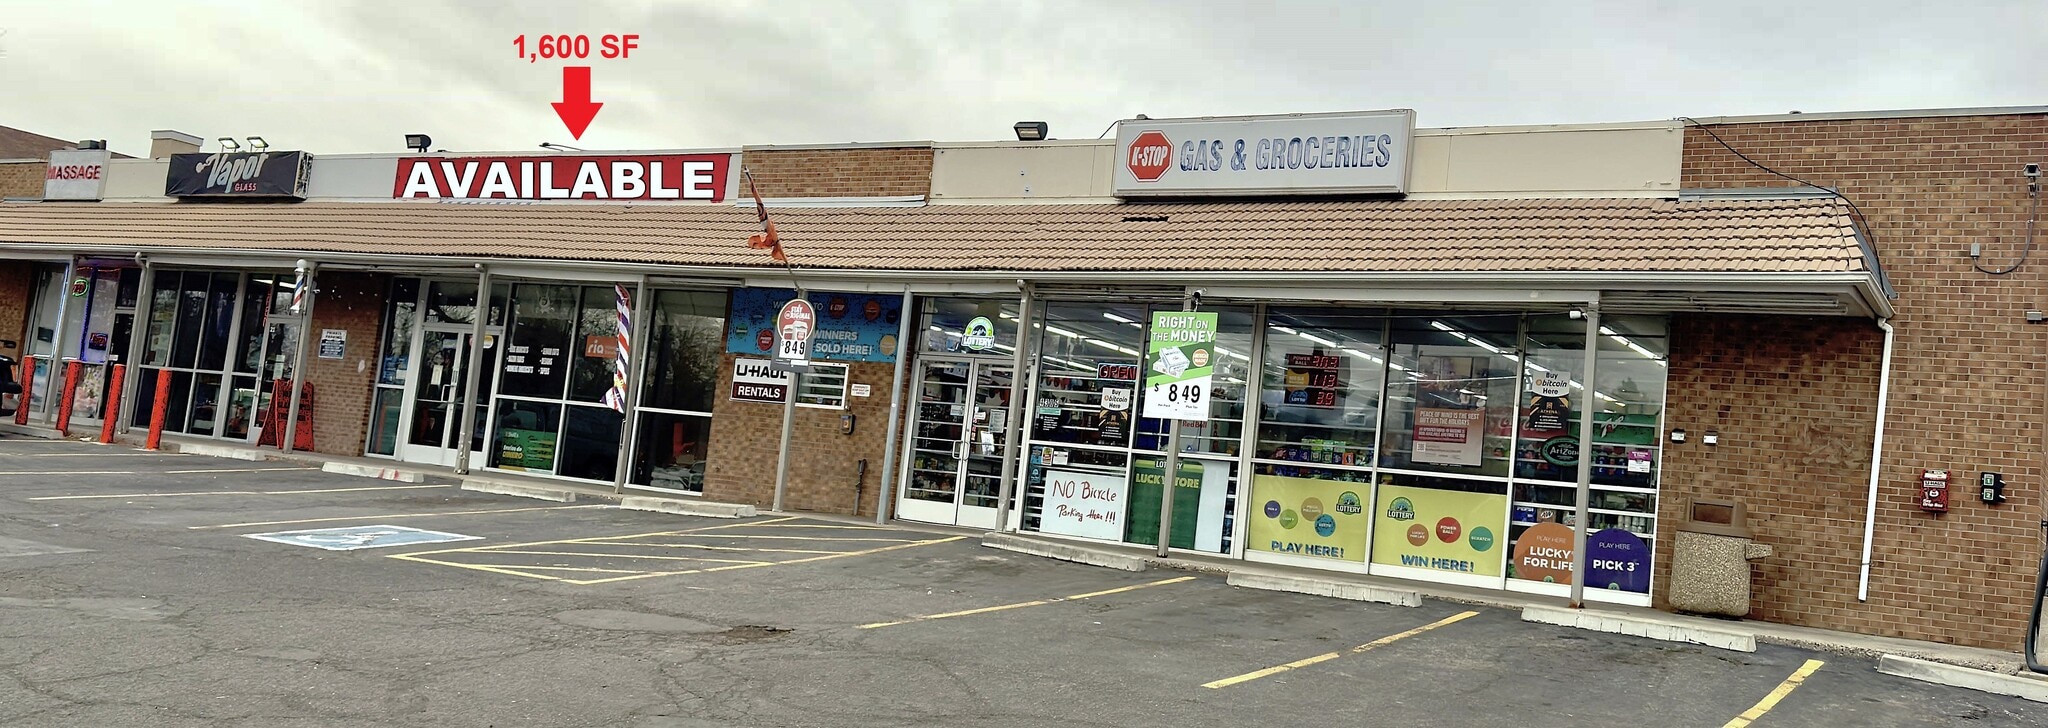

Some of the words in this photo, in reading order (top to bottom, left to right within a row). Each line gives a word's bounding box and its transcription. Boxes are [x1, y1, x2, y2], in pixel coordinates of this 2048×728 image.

[1131, 145, 1169, 167] K-STOP
[1180, 139, 1224, 171] GAS
[1230, 138, 1248, 171] &
[1255, 133, 1392, 171] GROCERIES
[47, 164, 102, 180] MASSAGE
[197, 153, 269, 194] Vapor
[402, 160, 716, 199] AVAILABLE
[234, 183, 257, 191] GLASS
[814, 302, 824, 311] TO
[1158, 315, 1196, 329] RIGHT
[1195, 320, 1209, 329] ON
[813, 329, 858, 341] WINNERS
[1152, 332, 1169, 341] THE
[1170, 329, 1215, 343] MONEY
[587, 339, 604, 354] ria
[815, 343, 841, 353] SOLD
[842, 344, 873, 356] HERE!
[736, 364, 788, 379] U-HAUL
[1099, 365, 1137, 380] OPEN
[1546, 372, 1558, 380] Buy
[1542, 380, 1568, 388] bitcoin
[738, 385, 781, 398] RENTALS
[1053, 479, 1076, 499] NO
[1174, 477, 1200, 488] TORE
[1056, 504, 1084, 522] Parking
[1336, 505, 1361, 513] LOTTERY
[1388, 510, 1414, 519] LOTTERY
[1271, 540, 1304, 553] PLAY
[1305, 544, 1345, 558] HERE!
[1599, 541, 1614, 549] PLAY
[1529, 546, 1571, 559] LUCKY
[1401, 554, 1429, 567] WIN
[1432, 557, 1474, 572] HERE!
[1523, 556, 1548, 568] FOR
[1550, 560, 1574, 572] LIFE
[1592, 559, 1624, 571] PICK
